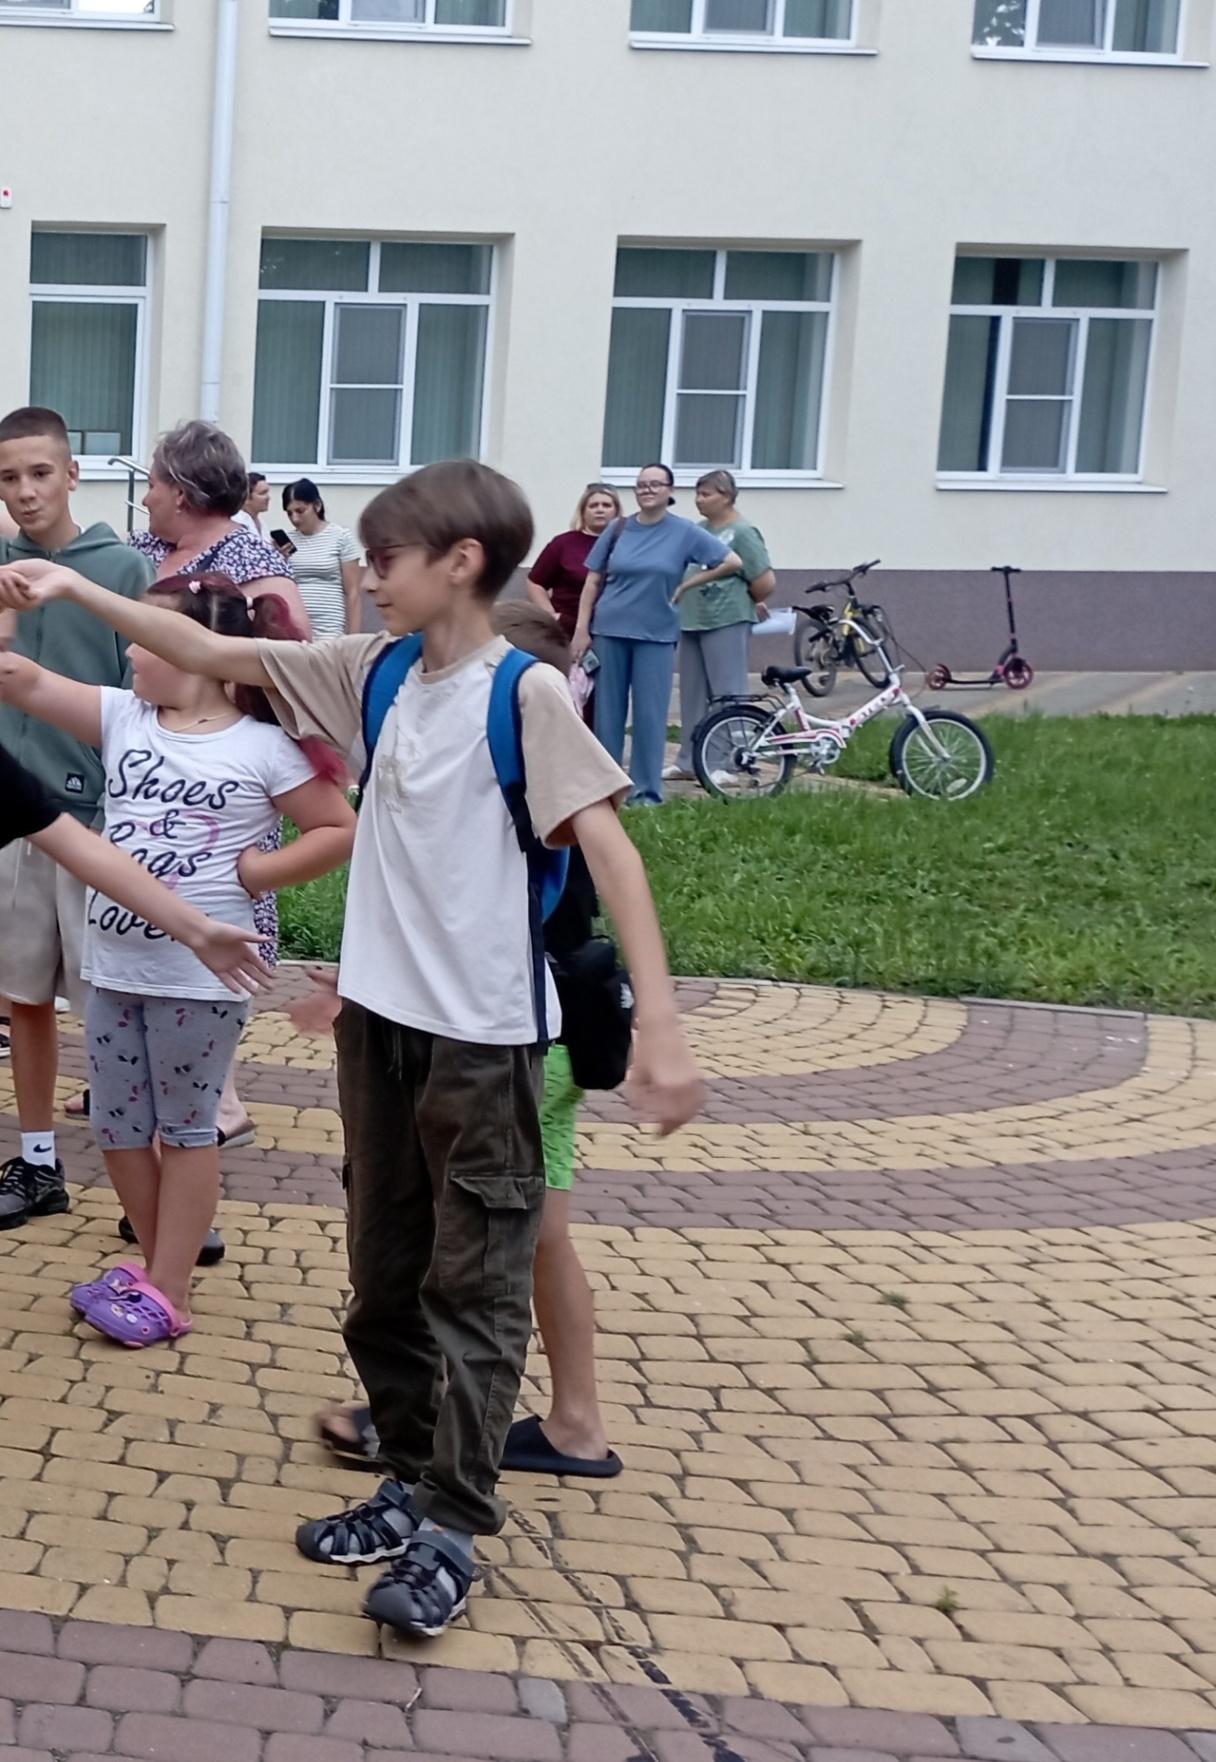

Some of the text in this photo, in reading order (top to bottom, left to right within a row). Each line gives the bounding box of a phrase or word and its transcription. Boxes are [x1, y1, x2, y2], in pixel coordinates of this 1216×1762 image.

[108, 749, 238, 810] Shoes
[149, 809, 186, 839] &
[88, 891, 176, 942] Love
